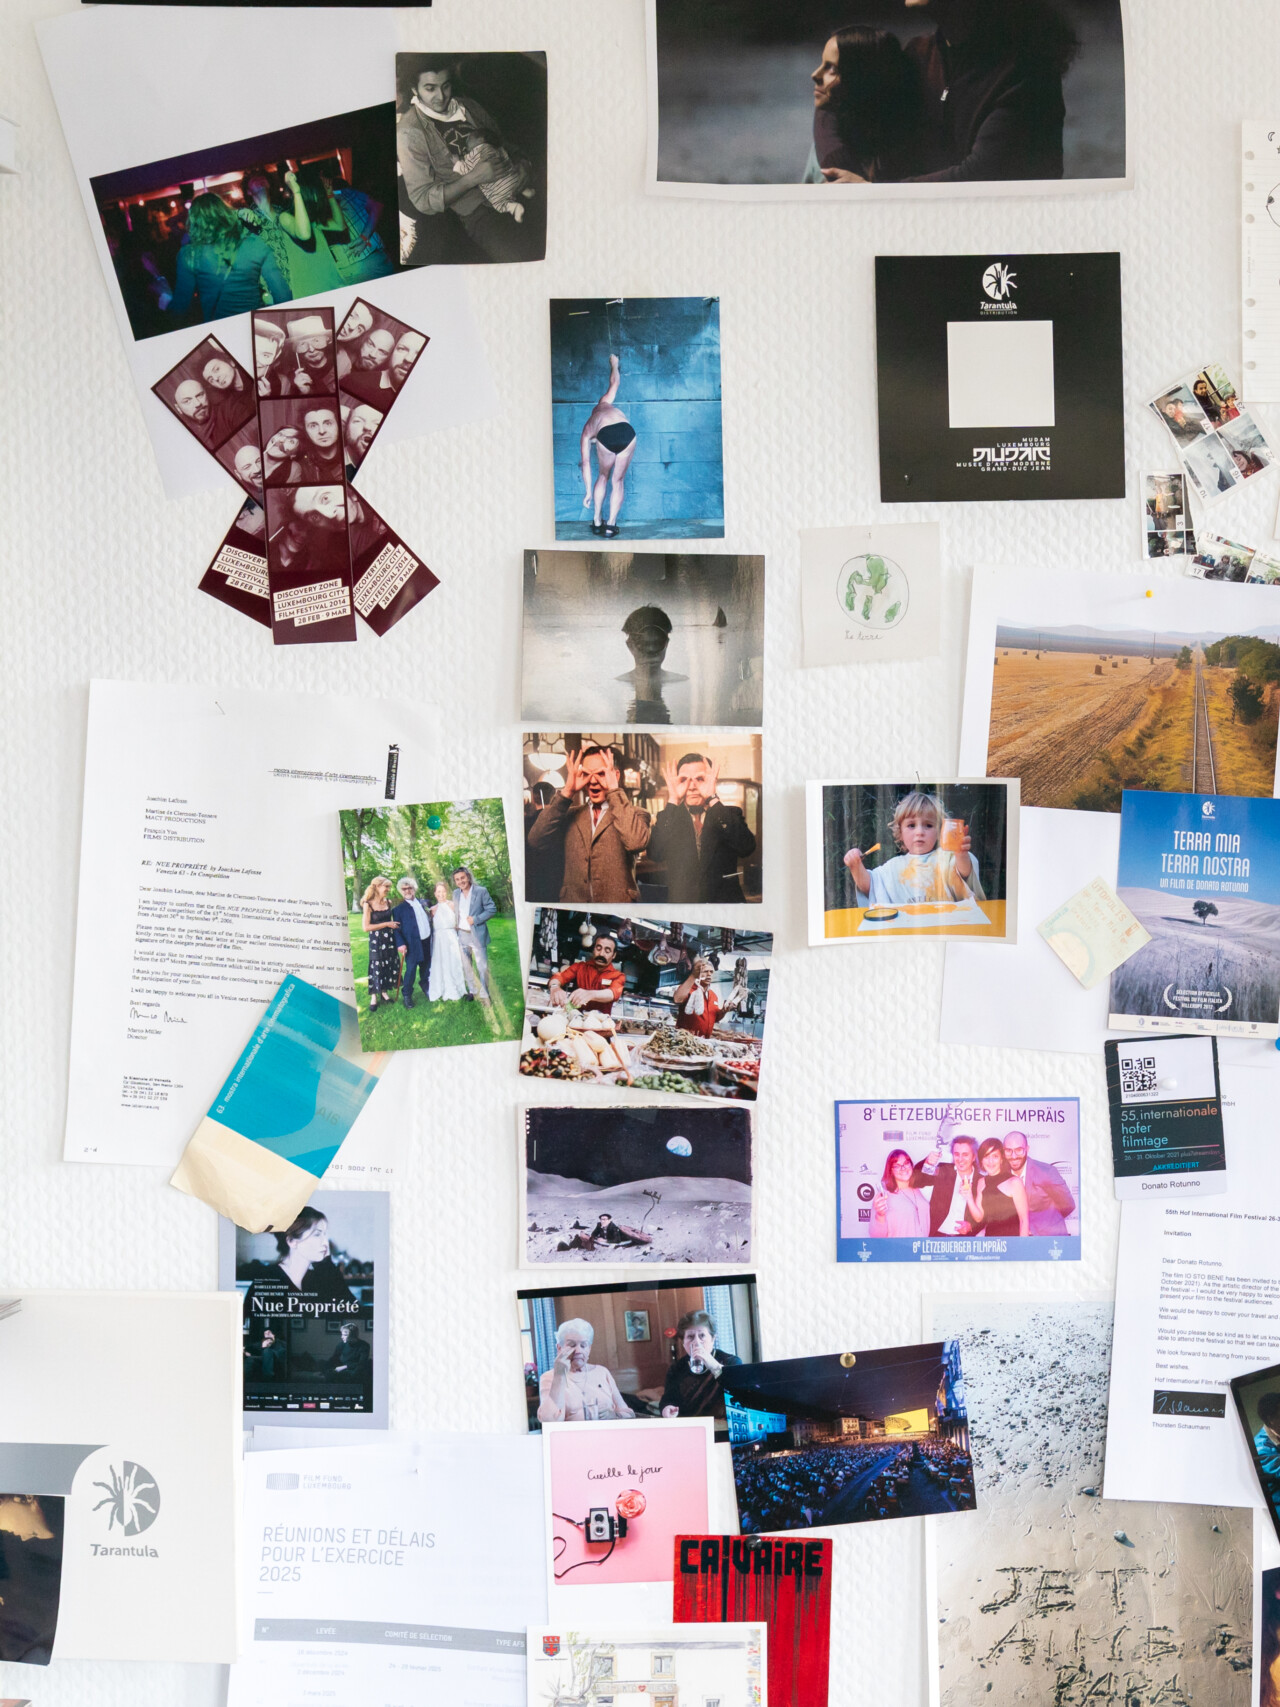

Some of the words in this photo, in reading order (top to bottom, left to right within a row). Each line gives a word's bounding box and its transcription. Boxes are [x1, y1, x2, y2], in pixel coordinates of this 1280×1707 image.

[980, 301, 1017, 310] Tarantula
[277, 586, 317, 599] DISCOVERY
[319, 581, 338, 591] ZONE
[278, 594, 328, 609] LUXEMBOURG
[329, 589, 345, 599] CITY
[279, 610, 295, 618] FILM
[297, 603, 328, 615] FESTIVAL
[329, 599, 346, 608] 2014
[308, 614, 320, 622] FEB
[332, 608, 347, 617] MAR
[1174, 830, 1211, 852] TERRA
[1216, 833, 1240, 853] MIA
[1161, 853, 1199, 874] TERRA
[1203, 856, 1250, 877] NOSTRA
[1160, 878, 1169, 888] UN
[1170, 879, 1185, 889] FILM
[1187, 880, 1194, 890] DE
[1196, 880, 1219, 891] DONATO
[1221, 881, 1249, 892] ROTUNNO
[216, 1105, 225, 1114] 63
[224, 1083, 238, 1102] mostra
[236, 1043, 260, 1082] internazionale
[268, 983, 295, 1027] cinematografica
[880, 1105, 991, 1121] LËTZEBUERGER
[996, 1106, 1065, 1123] FILMPRÄIS
[1121, 1110, 1138, 1122] 55.
[1140, 1105, 1217, 1120] internationale
[1121, 1122, 1152, 1135] hofer
[1122, 1134, 1169, 1149] filmtage
[1152, 1161, 1199, 1171] AKKREDITIERT
[1141, 1181, 1168, 1190] Donato
[1170, 1178, 1201, 1188] Rotunno
[1191, 1210, 1228, 1220] International
[922, 1239, 971, 1253] LËTZEBUERGER
[973, 1239, 1007, 1253] FILMPRÄIS
[251, 1296, 284, 1312] Nue
[287, 1296, 359, 1318] Propriété
[587, 1466, 623, 1481] Cueille
[627, 1465, 637, 1476] le
[638, 1466, 663, 1483] jour
[262, 1523, 345, 1544] RÉUNIONS
[352, 1528, 371, 1545] ET
[377, 1525, 436, 1549] DÉLAIS
[90, 1542, 159, 1559] Tarantula
[261, 1546, 305, 1563] POUR
[311, 1546, 405, 1567] L'EXERCICE
[680, 1537, 823, 1576] CALVAIRE
[259, 1565, 301, 1583] 2025
